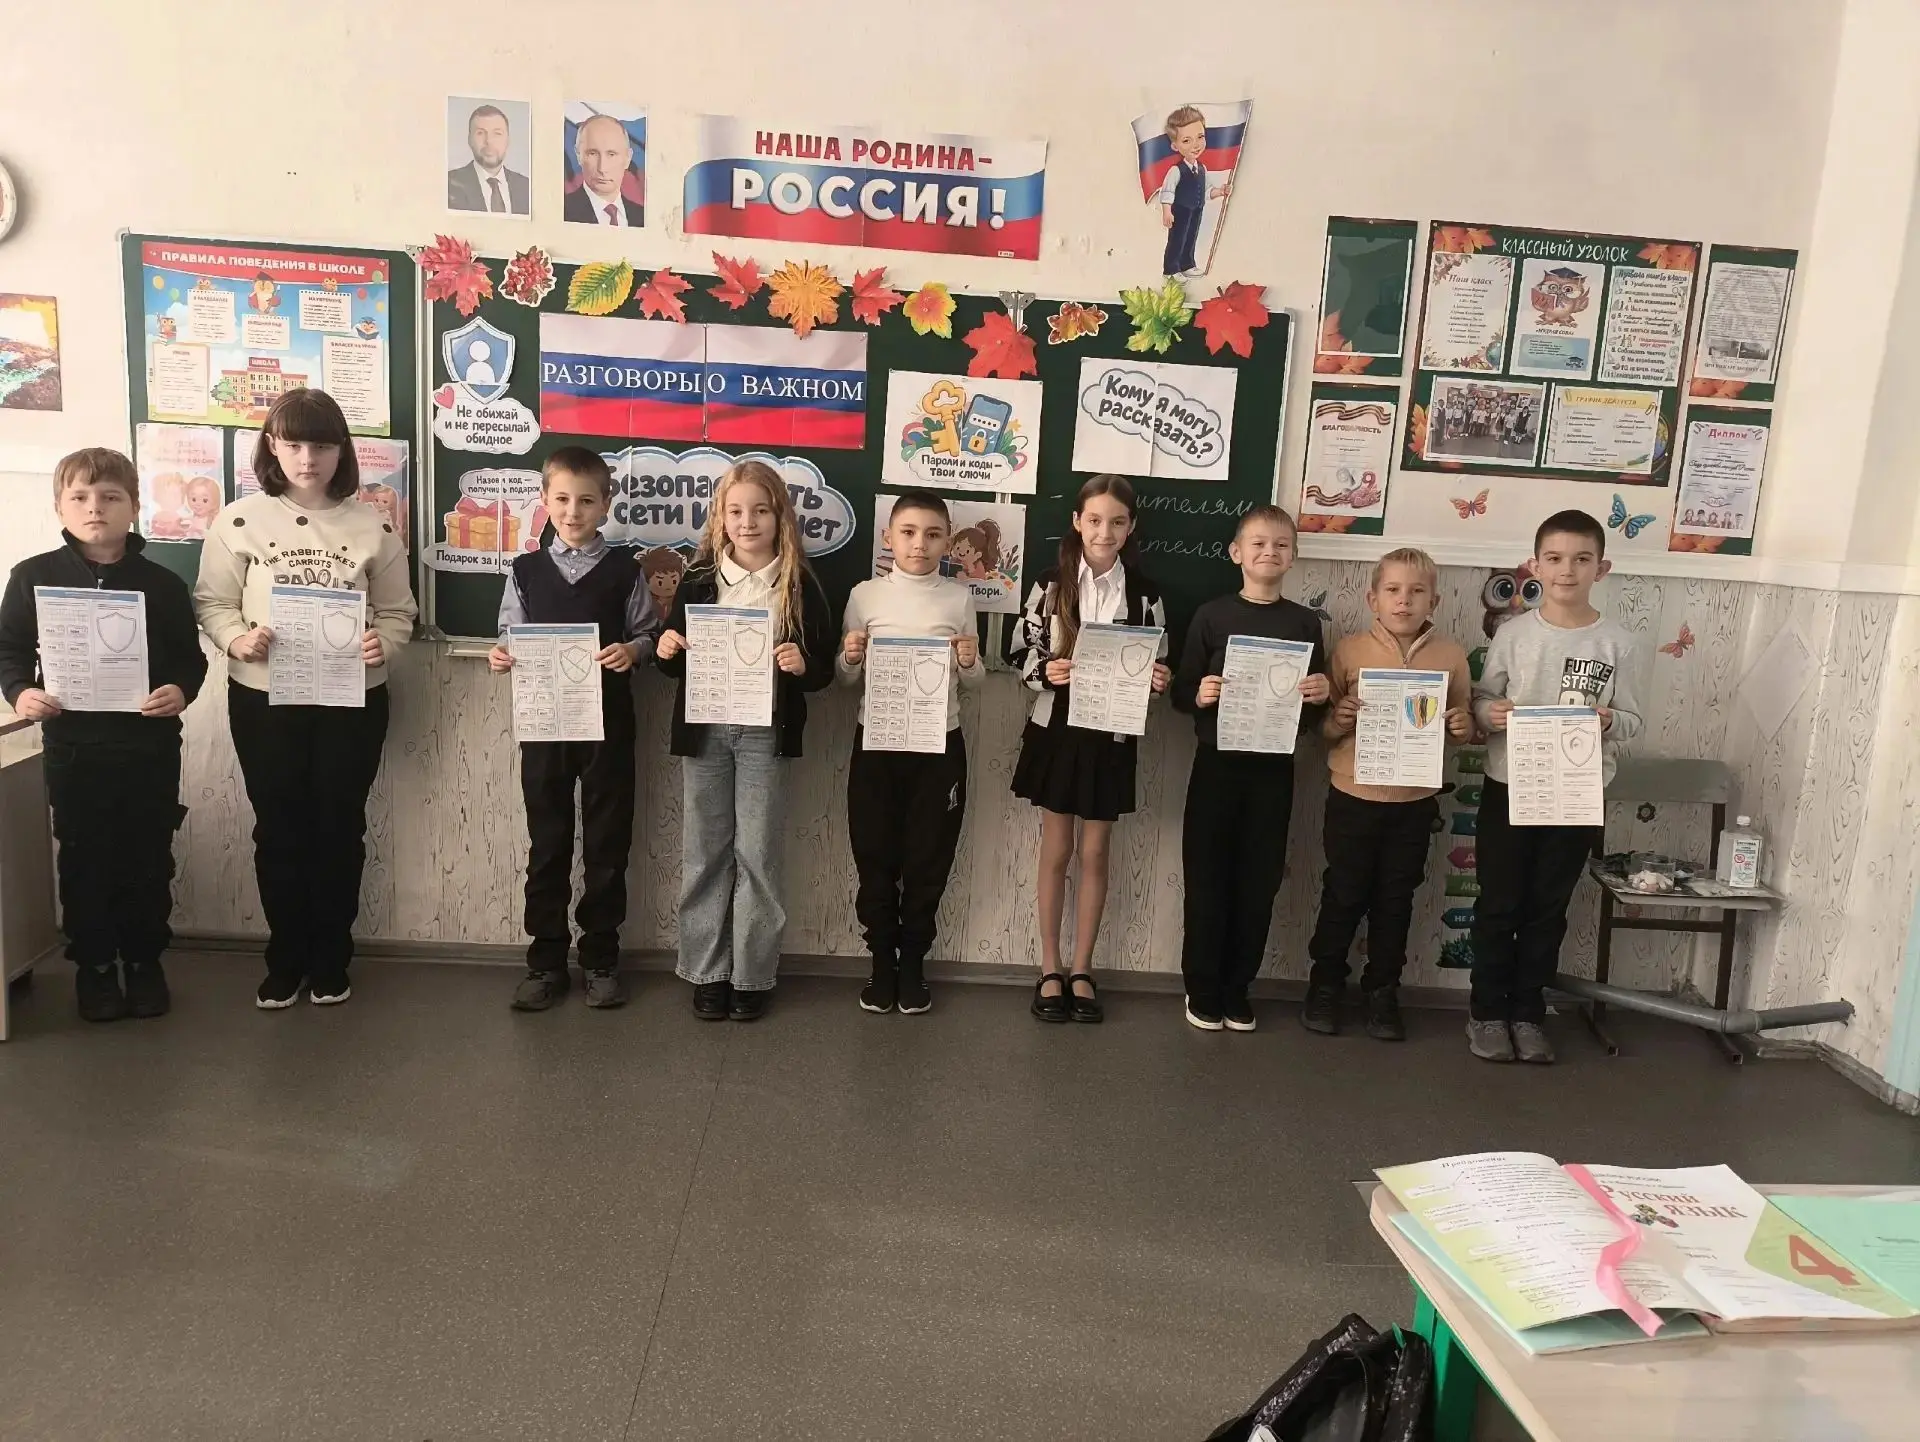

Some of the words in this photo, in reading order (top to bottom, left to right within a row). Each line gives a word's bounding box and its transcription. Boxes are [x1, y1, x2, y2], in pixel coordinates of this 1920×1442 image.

[755, 130, 842, 161] НАША
[731, 167, 1007, 230] РОССИЯ!
[1502, 237, 1574, 258] КЛАССНЫЙ
[1576, 244, 1629, 262] УГОЛОК
[161, 251, 226, 266] ПРАВИЛА
[228, 256, 306, 270] ПОВЕДЕНИЯ
[308, 262, 316, 271] В
[318, 263, 366, 275] ШКОЛЕ
[542, 362, 702, 393] РАЗГОВОРЫ
[707, 373, 726, 394] О
[741, 374, 864, 401] ВАЖНОМ
[457, 405, 472, 418] Не
[476, 407, 518, 420] обижай
[1105, 375, 1155, 408] Кому
[1169, 404, 1215, 440] могу
[445, 421, 452, 430] и
[455, 422, 469, 430] не
[472, 421, 530, 434] пересылай
[1098, 398, 1214, 459] рассказать?
[1707, 428, 1748, 439] Диплом
[466, 432, 513, 446] обидное
[921, 454, 959, 469] Пароли
[959, 459, 966, 467] и
[968, 459, 993, 470] коды
[930, 467, 956, 478] твои
[508, 477, 523, 485] код
[608, 465, 823, 510] езопать
[613, 501, 684, 525] сети
[263, 554, 282, 568] THE
[281, 548, 323, 558] RABBIT
[325, 551, 357, 569] LIKES
[288, 558, 333, 569] CARROTS
[436, 549, 479, 565] Подарок
[481, 557, 492, 565] за
[969, 584, 1003, 600] Твори.
[1564, 657, 1614, 681] FUTURE
[1561, 674, 1606, 694] STREET
[1788, 1234, 1862, 1287] 4
